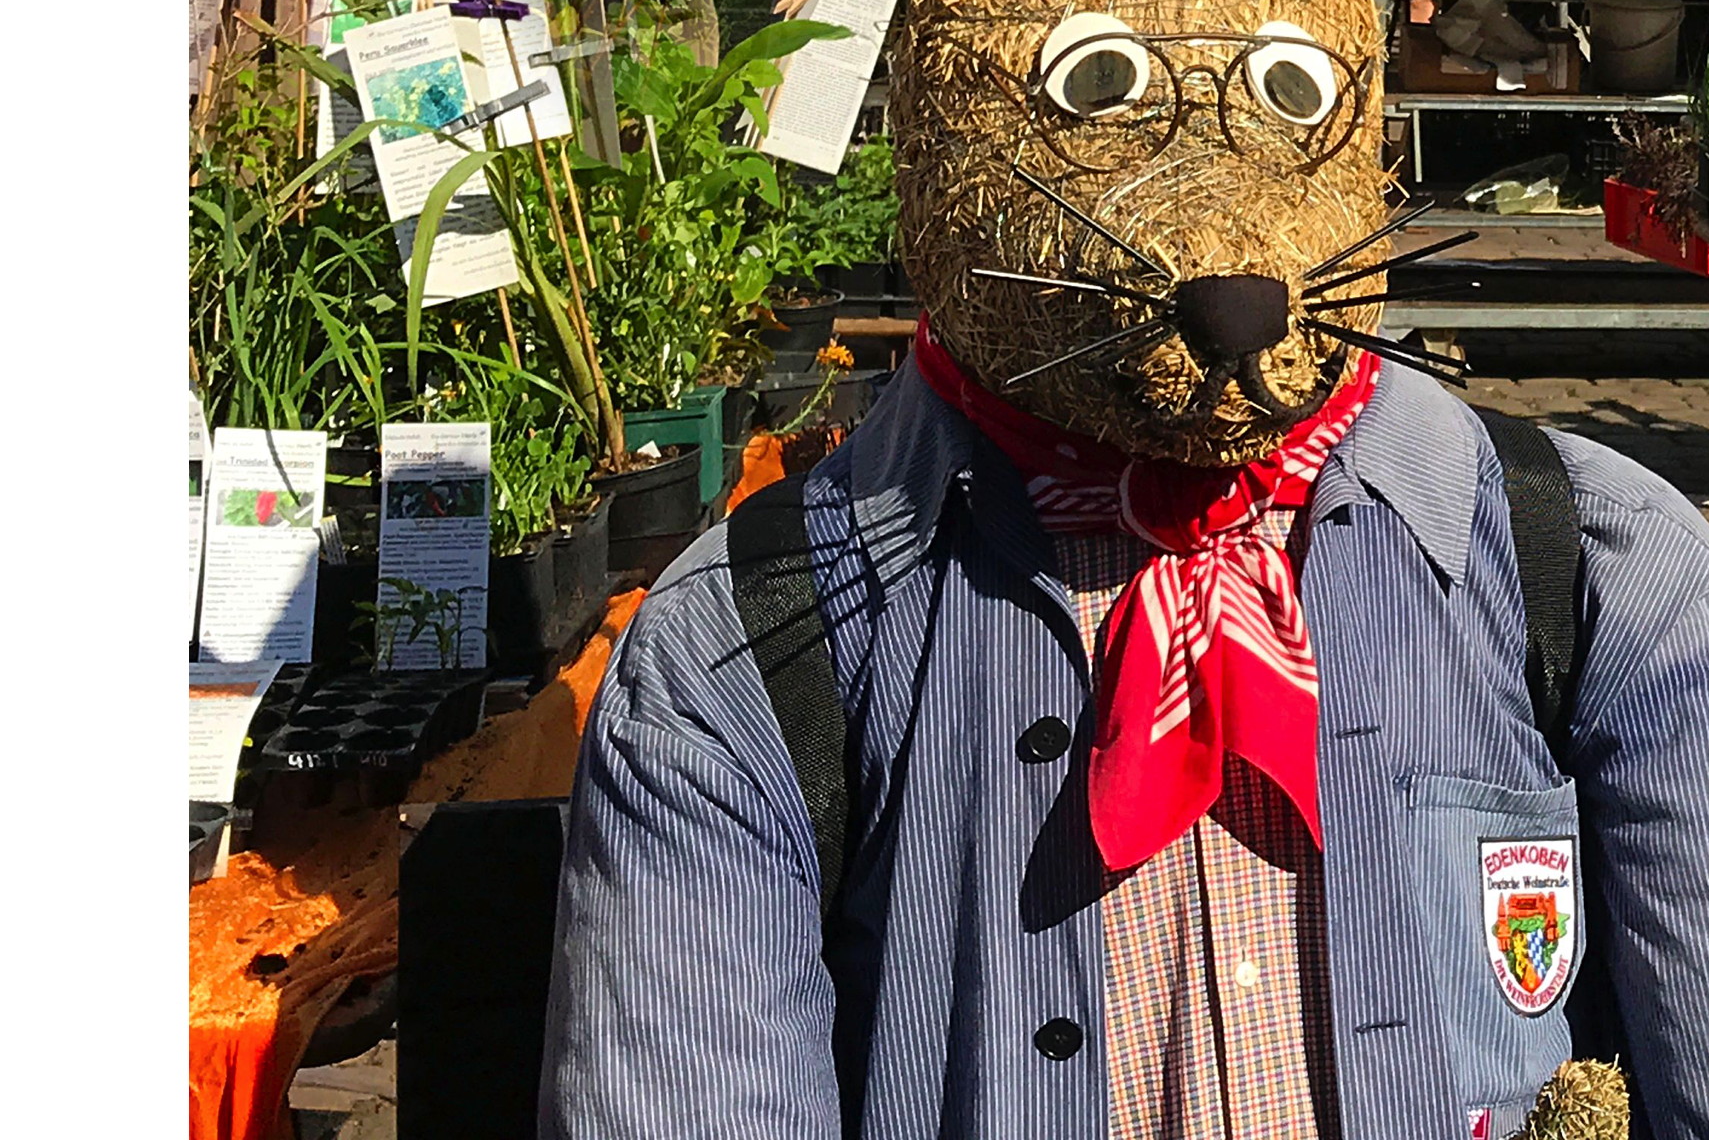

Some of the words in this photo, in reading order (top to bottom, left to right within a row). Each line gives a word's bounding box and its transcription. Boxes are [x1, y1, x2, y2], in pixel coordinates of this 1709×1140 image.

[411, 448, 446, 460] Pepper
[1484, 844, 1570, 876] EDENKOBEN
[1486, 876, 1520, 890] Deutsche
